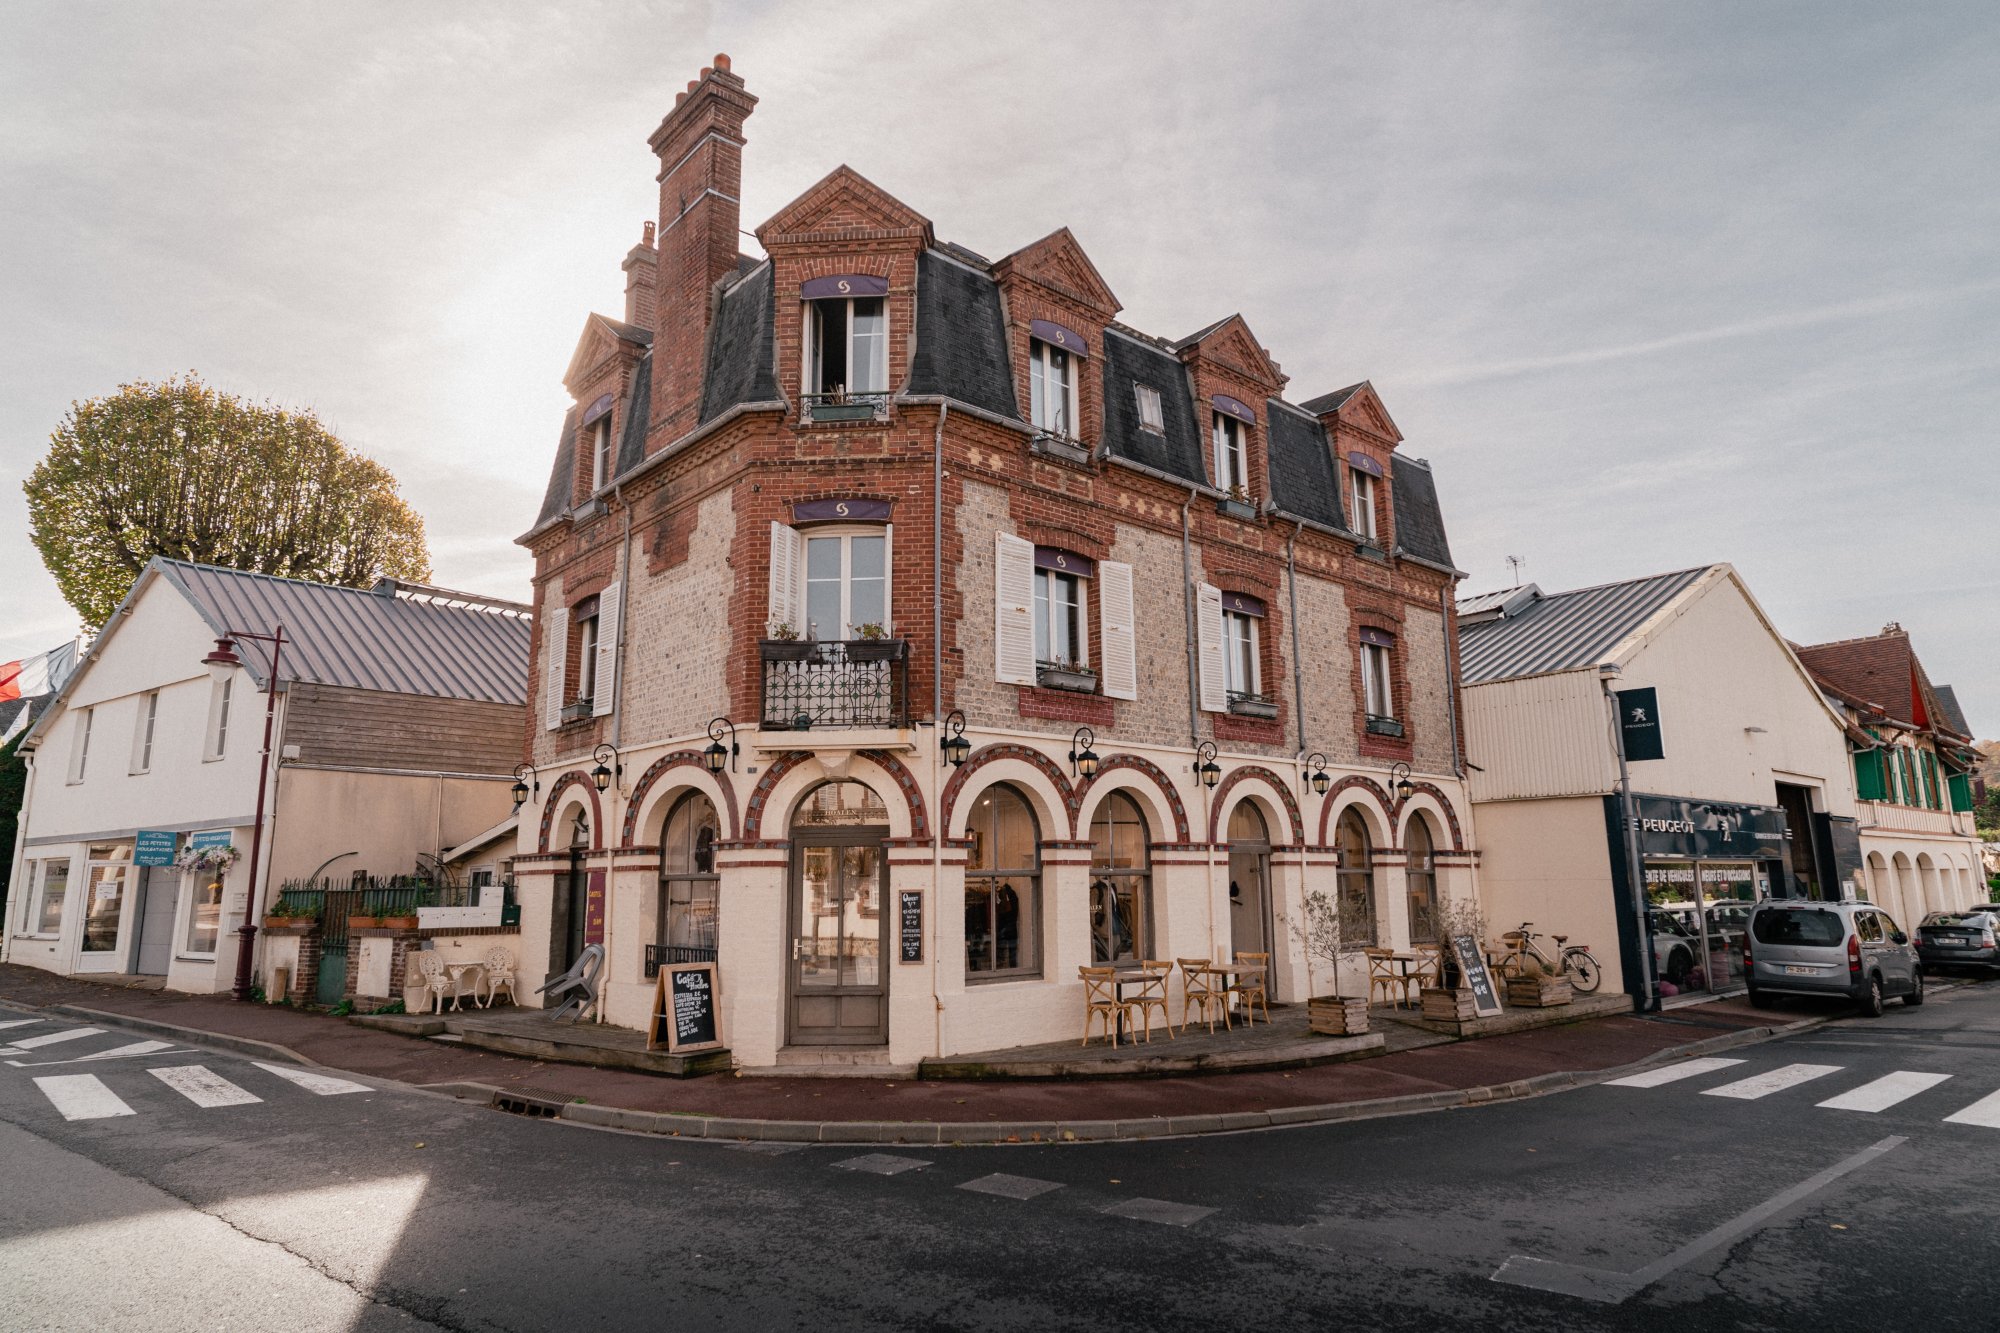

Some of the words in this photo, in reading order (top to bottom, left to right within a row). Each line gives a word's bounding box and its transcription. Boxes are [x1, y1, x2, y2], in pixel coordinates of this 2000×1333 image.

[1642, 818, 1696, 834] PEUGEOT
[1659, 869, 1667, 882] DE
[676, 972, 694, 988] Café
